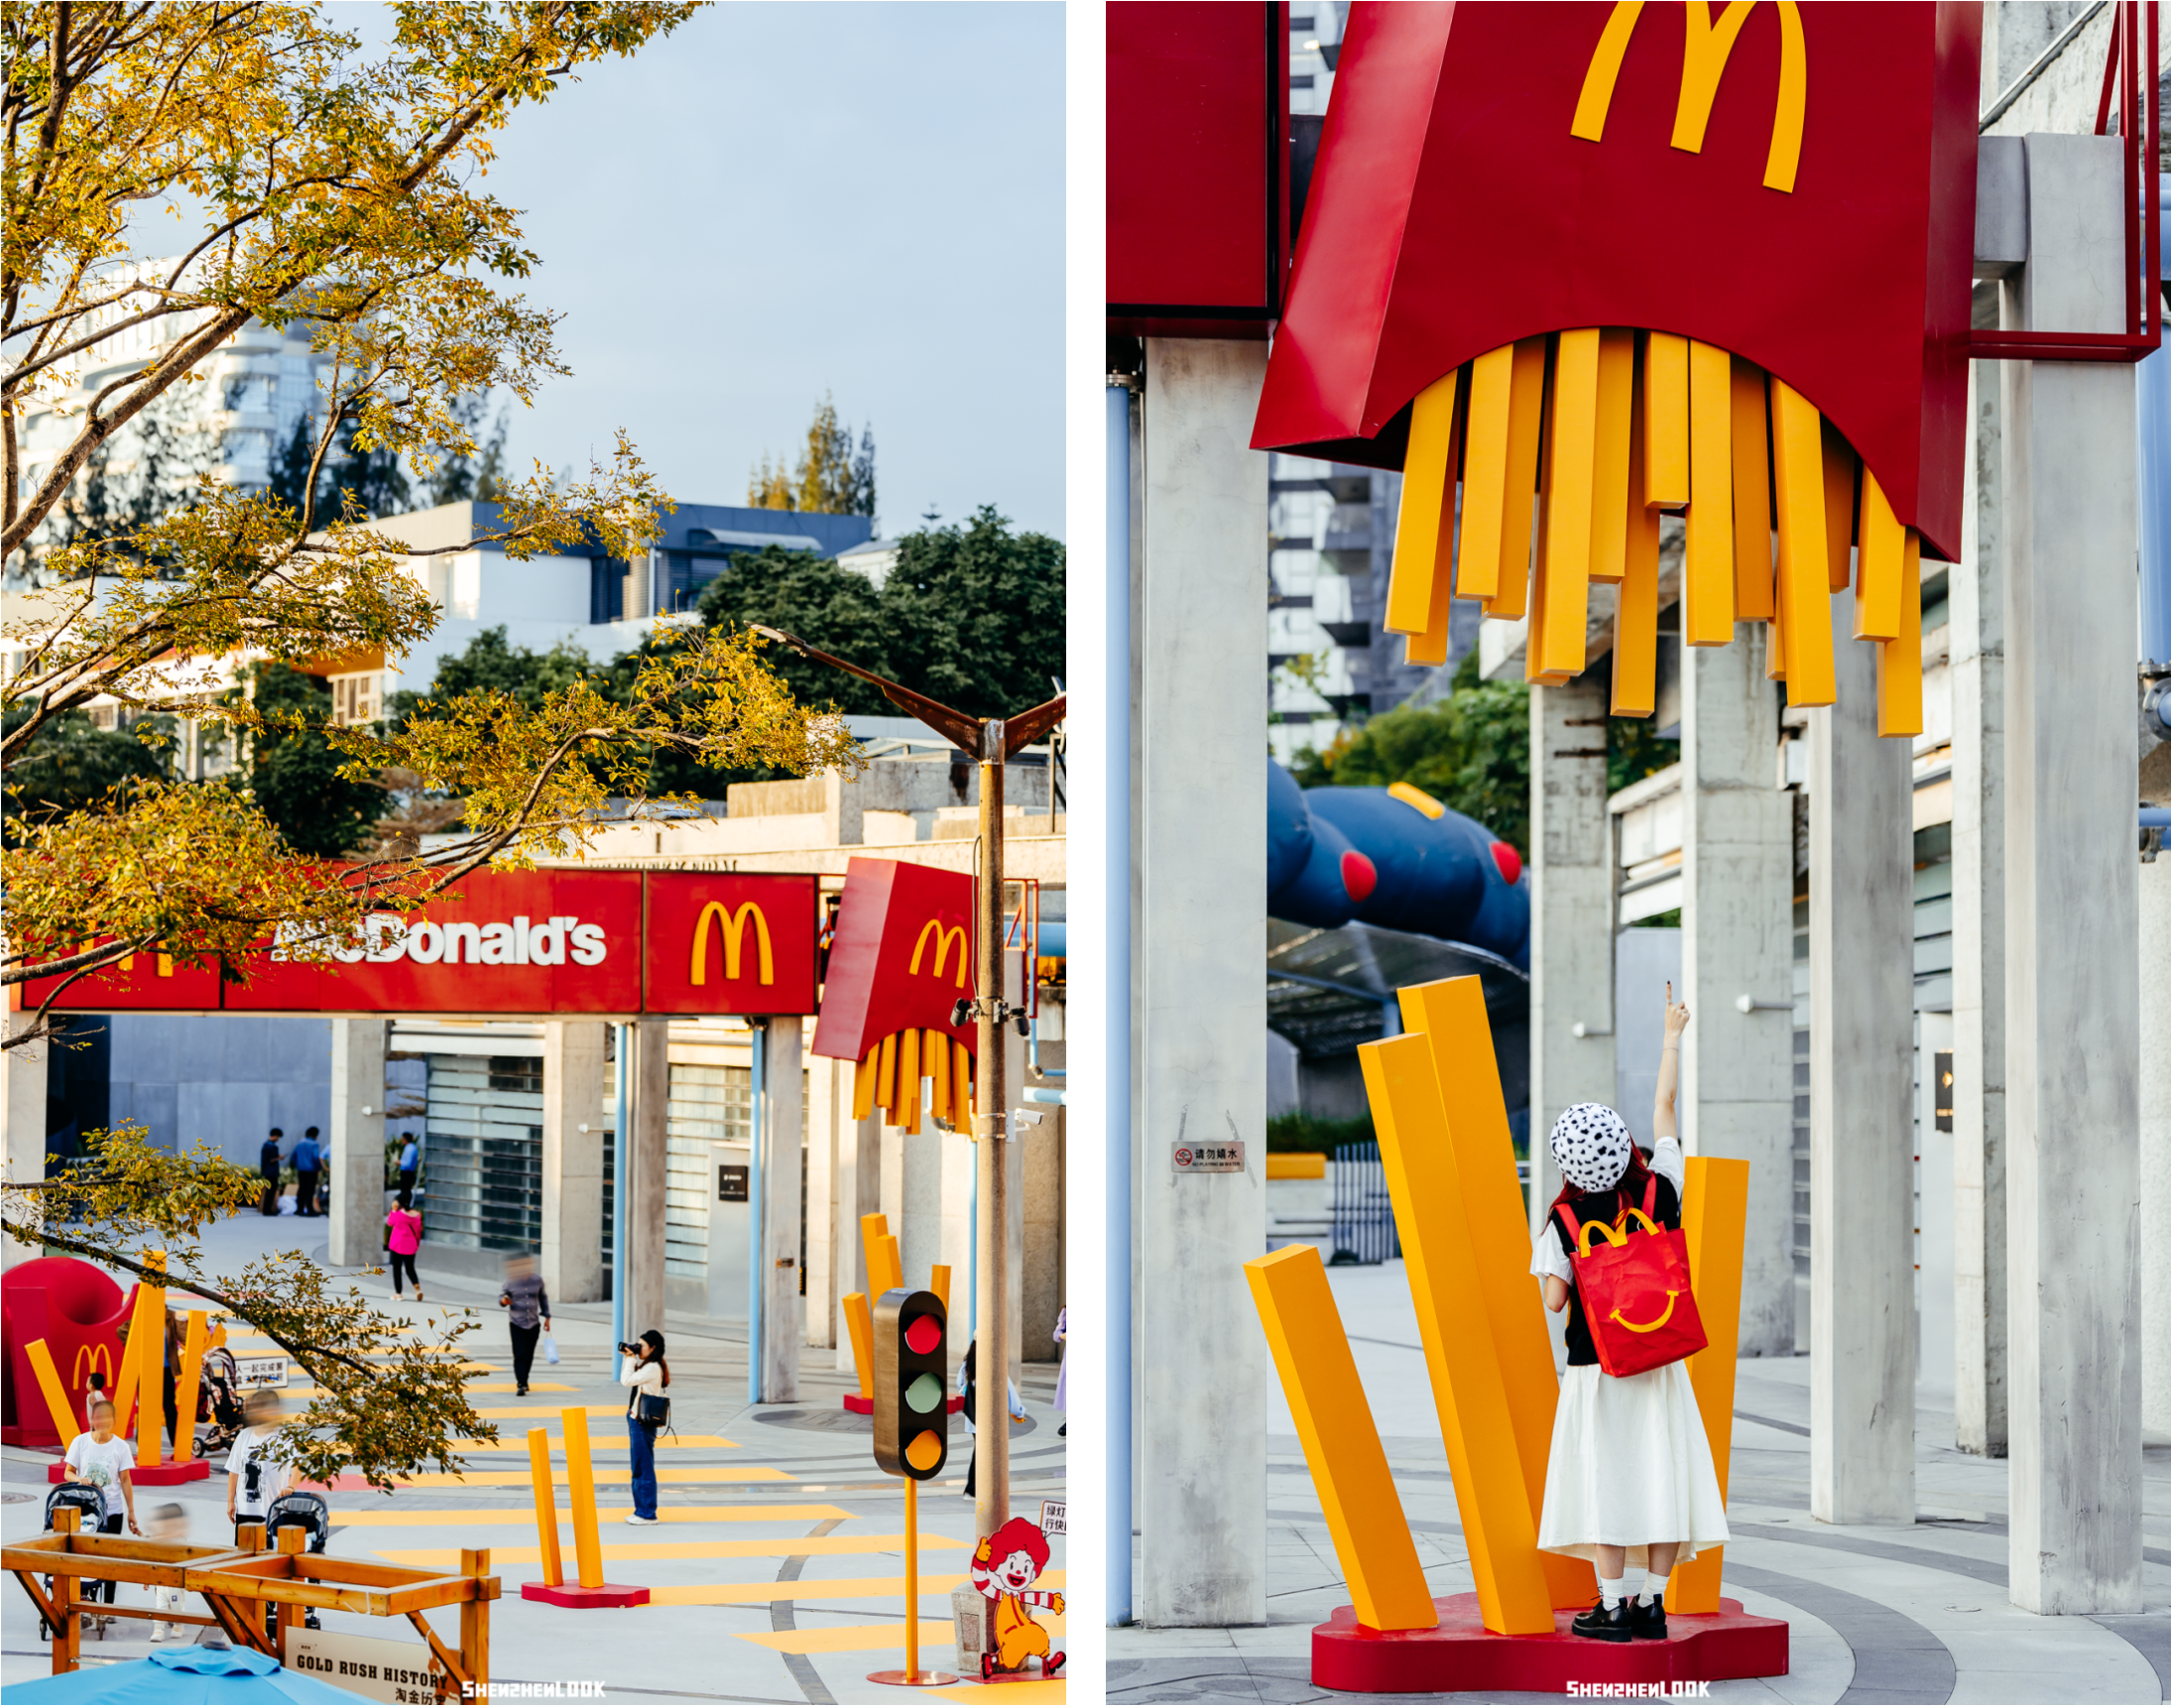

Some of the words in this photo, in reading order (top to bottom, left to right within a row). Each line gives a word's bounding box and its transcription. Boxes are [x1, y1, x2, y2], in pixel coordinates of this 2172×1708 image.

[1194, 1148, 1238, 1159] 请勿嬉水
[1046, 1505, 1065, 1518] 绿灯
[1045, 1519, 1066, 1530] 行快
[297, 1654, 333, 1672] GOLD
[339, 1660, 377, 1679] RUSH
[383, 1666, 448, 1689] HISTORY
